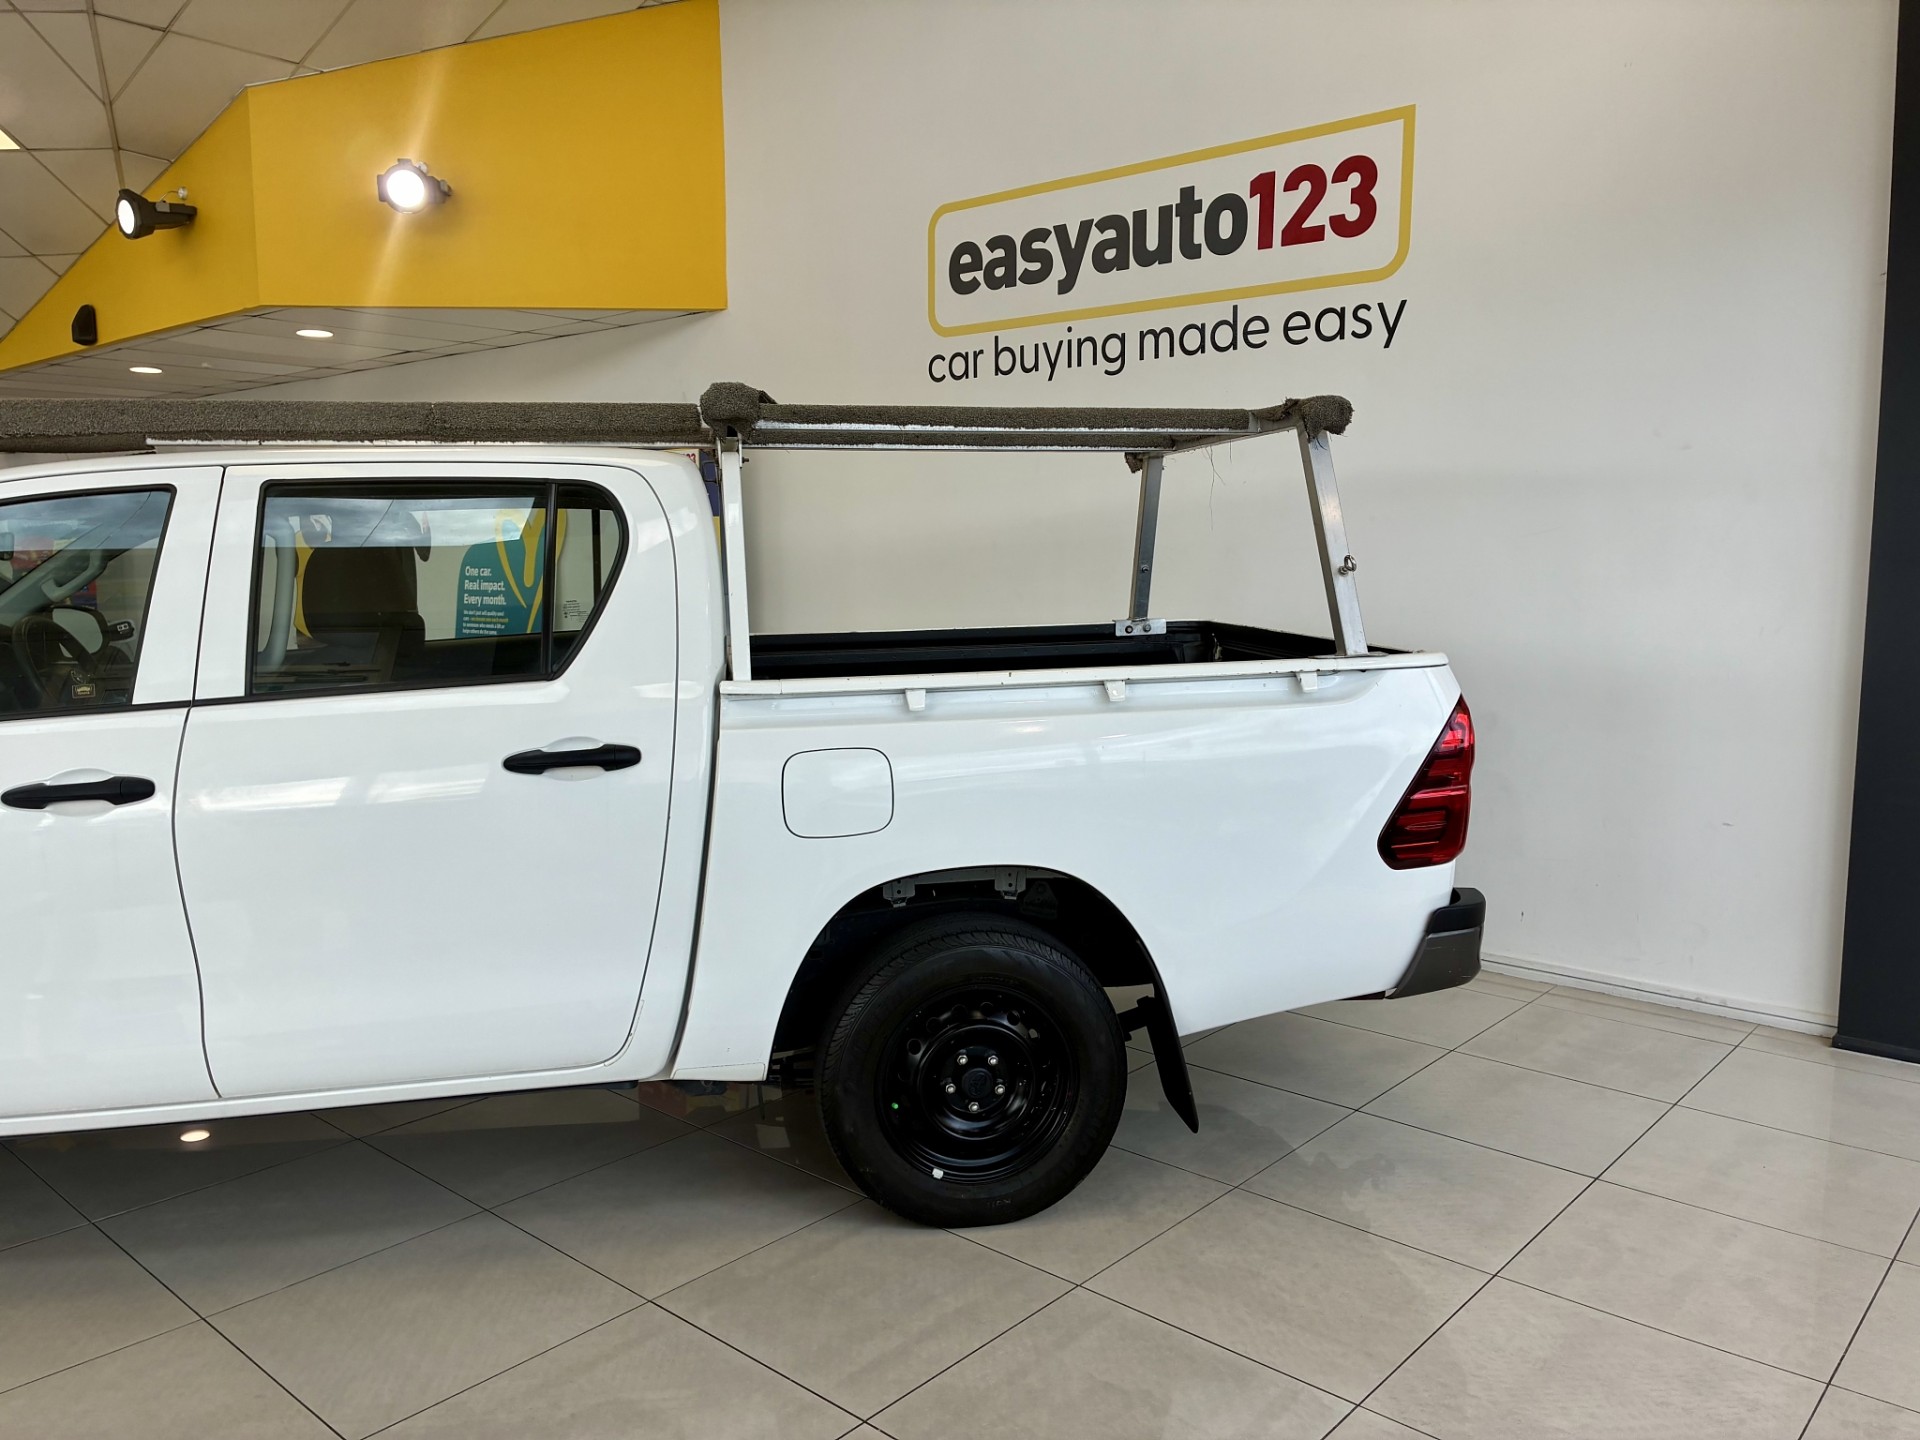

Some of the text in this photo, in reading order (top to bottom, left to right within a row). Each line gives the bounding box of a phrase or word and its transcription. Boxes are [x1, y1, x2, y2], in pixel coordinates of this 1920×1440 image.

[948, 155, 1378, 296] easyauto123
[928, 299, 1407, 382] car buying made easy
[465, 566, 492, 576] One car.
[464, 579, 506, 593] Real impact.
[463, 593, 507, 607] Every month.
